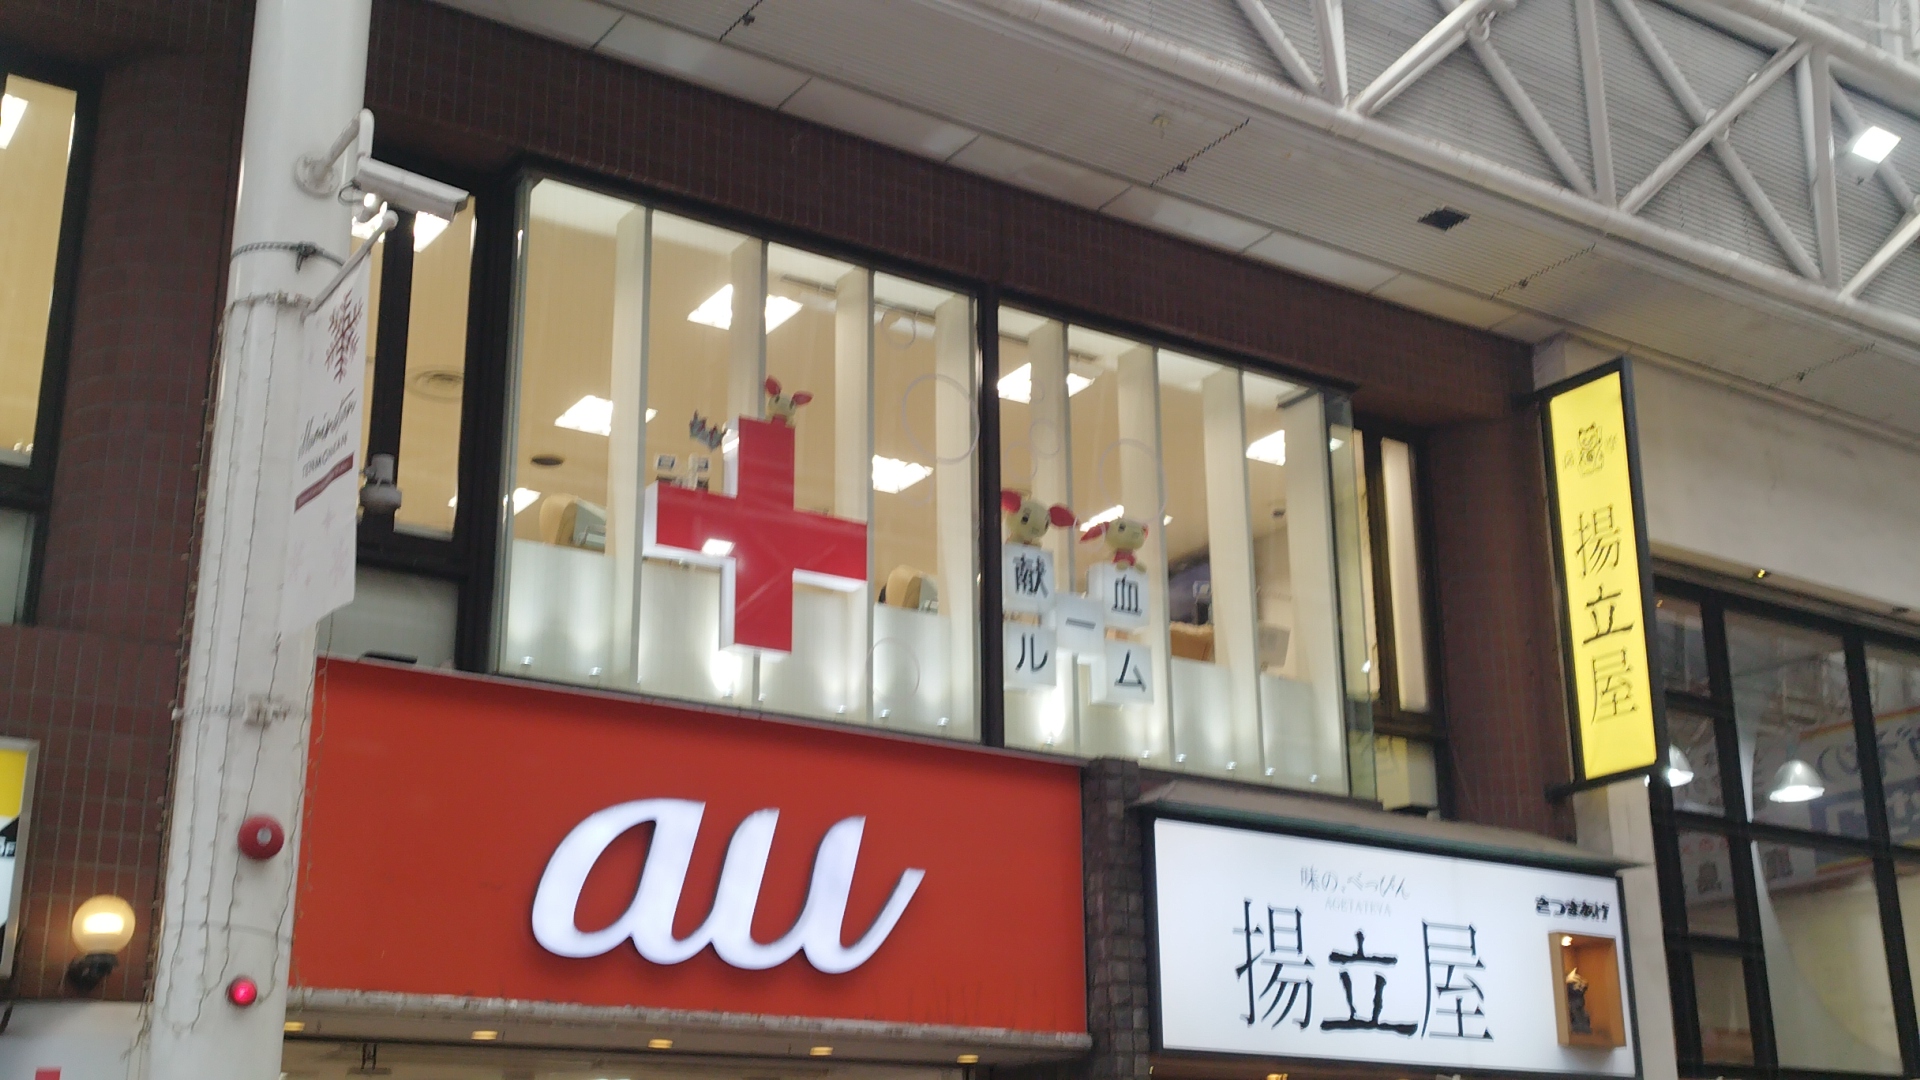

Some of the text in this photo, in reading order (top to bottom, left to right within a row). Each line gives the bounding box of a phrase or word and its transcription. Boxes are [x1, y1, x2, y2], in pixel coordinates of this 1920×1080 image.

[1574, 503, 1638, 723] 揚立屋
[532, 798, 926, 975] au
[1234, 897, 1494, 1042] 揚立屋
